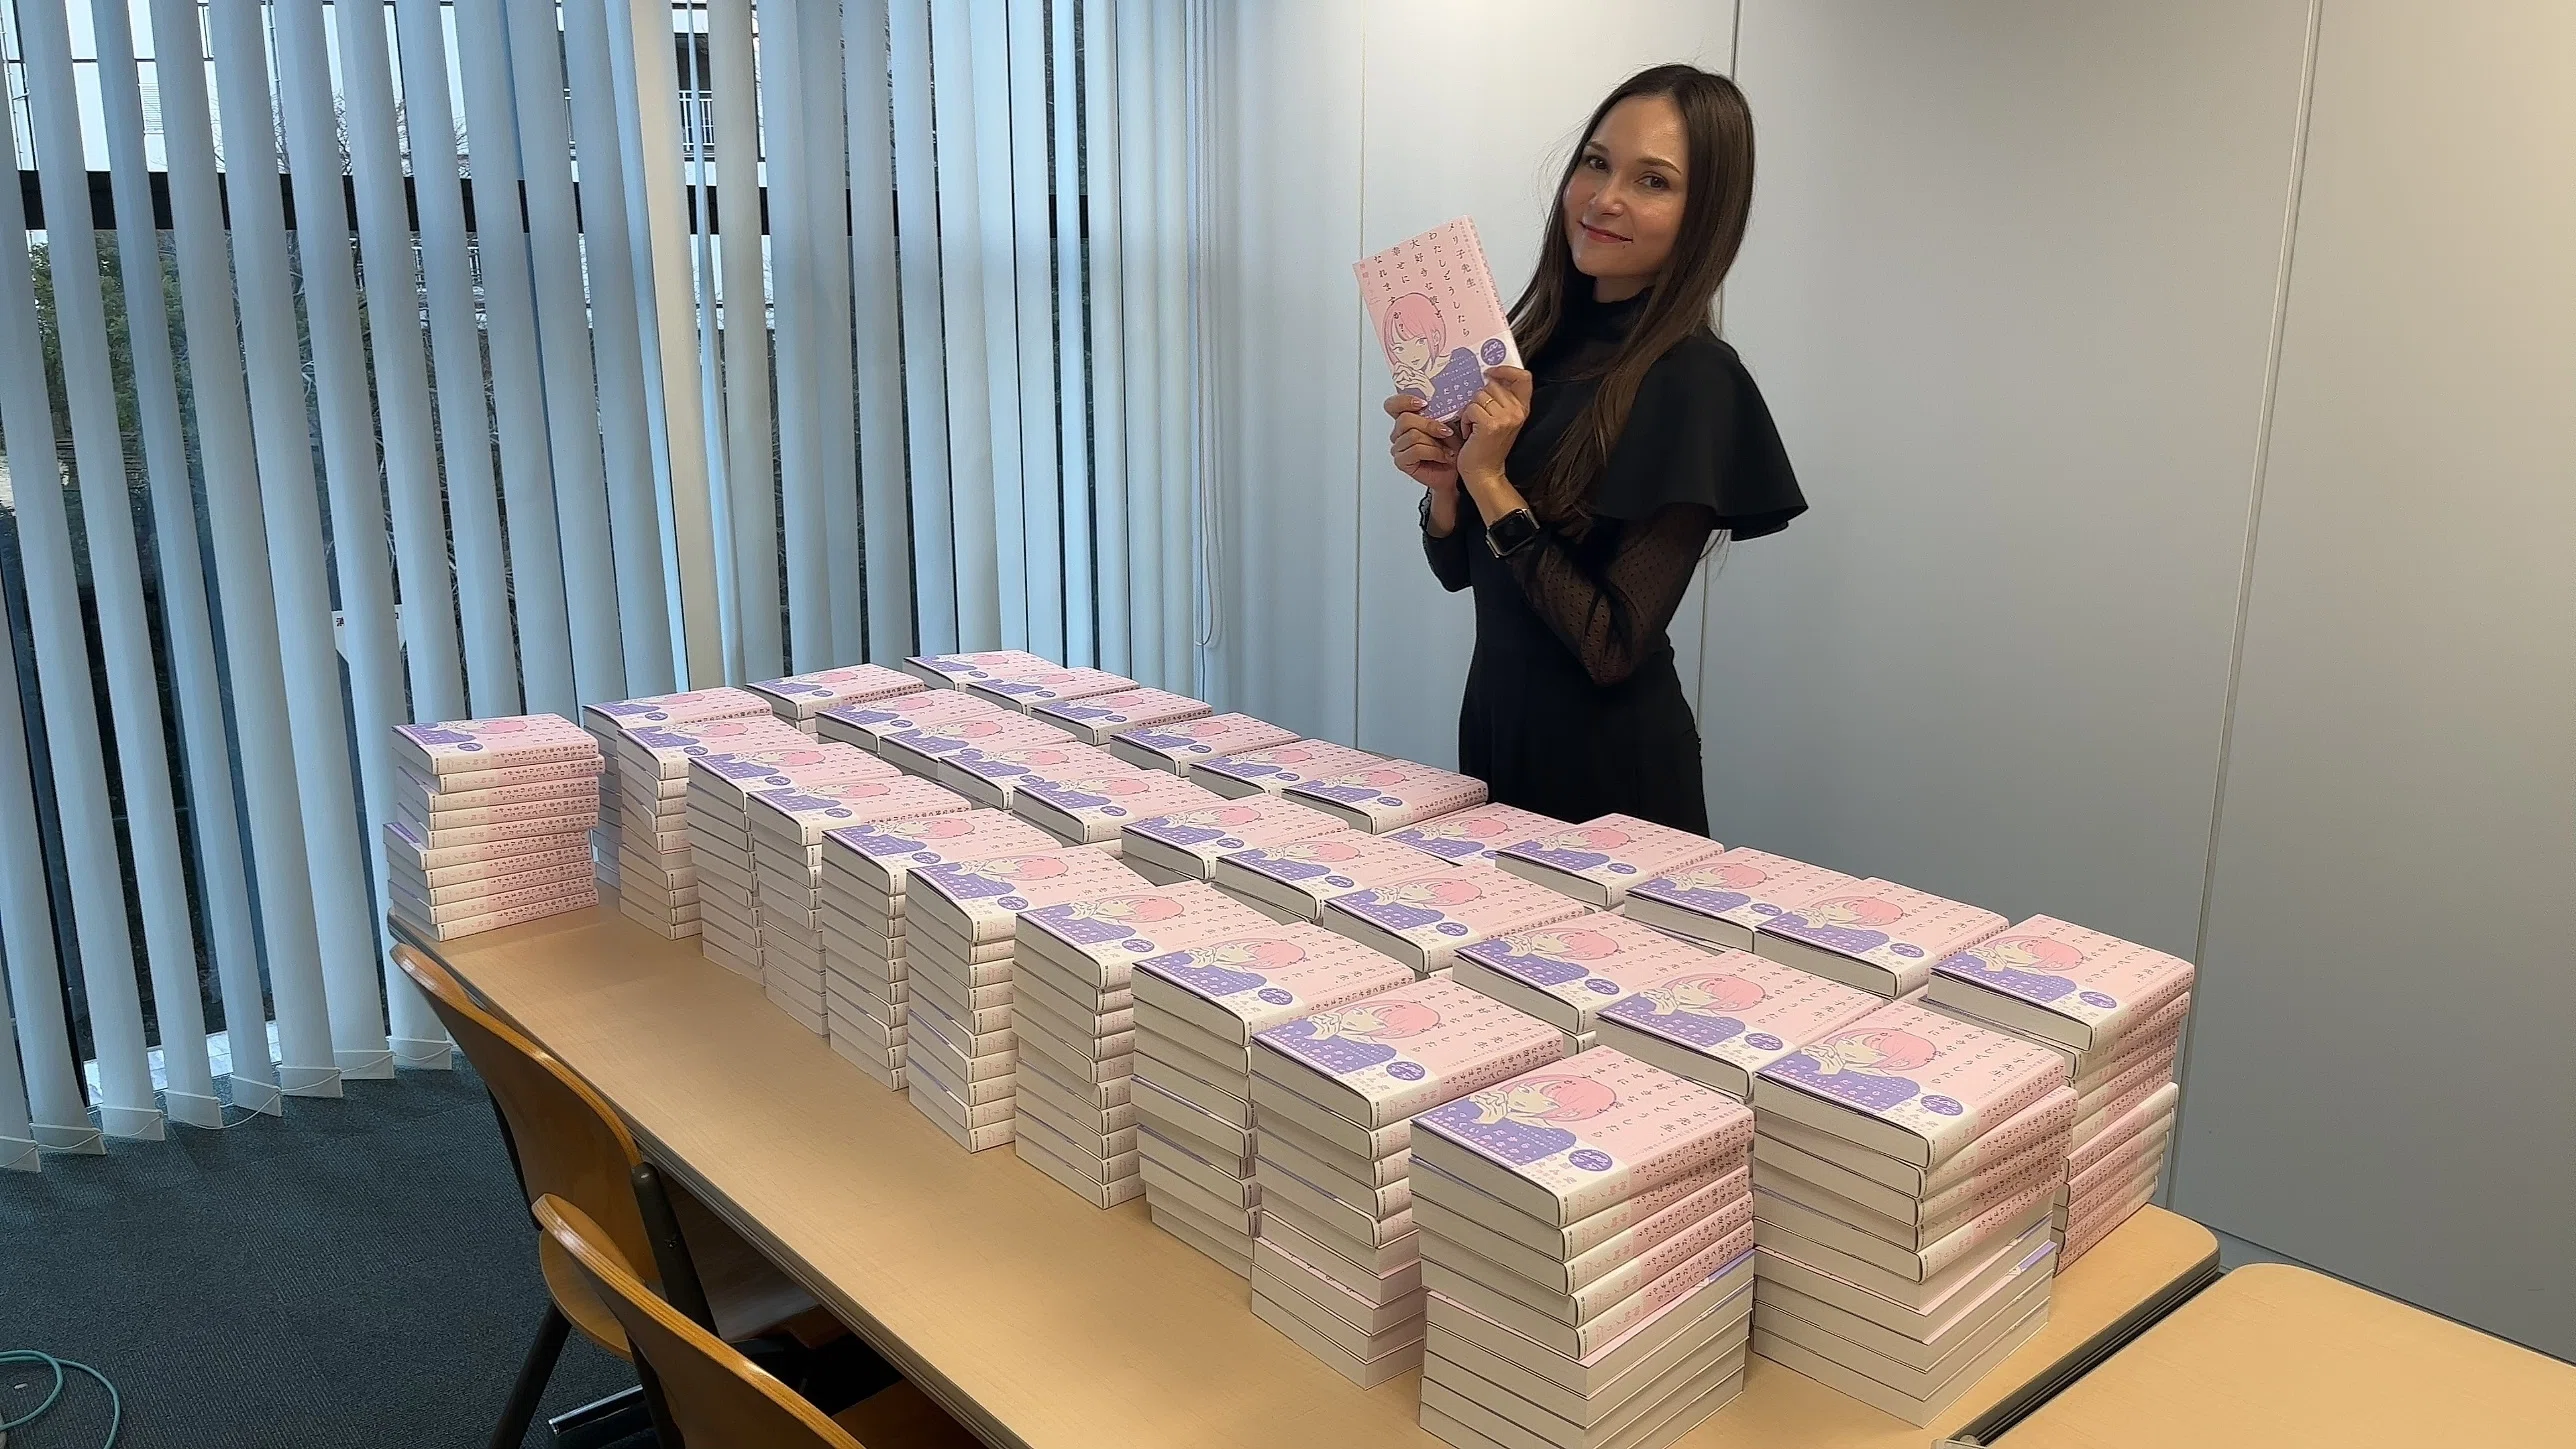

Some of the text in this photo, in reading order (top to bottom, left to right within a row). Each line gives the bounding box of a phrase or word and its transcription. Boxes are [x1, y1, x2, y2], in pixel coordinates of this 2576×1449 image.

[1429, 232, 1470, 336] わたしどうしたら
[1449, 223, 1479, 294] メリ子先生、
